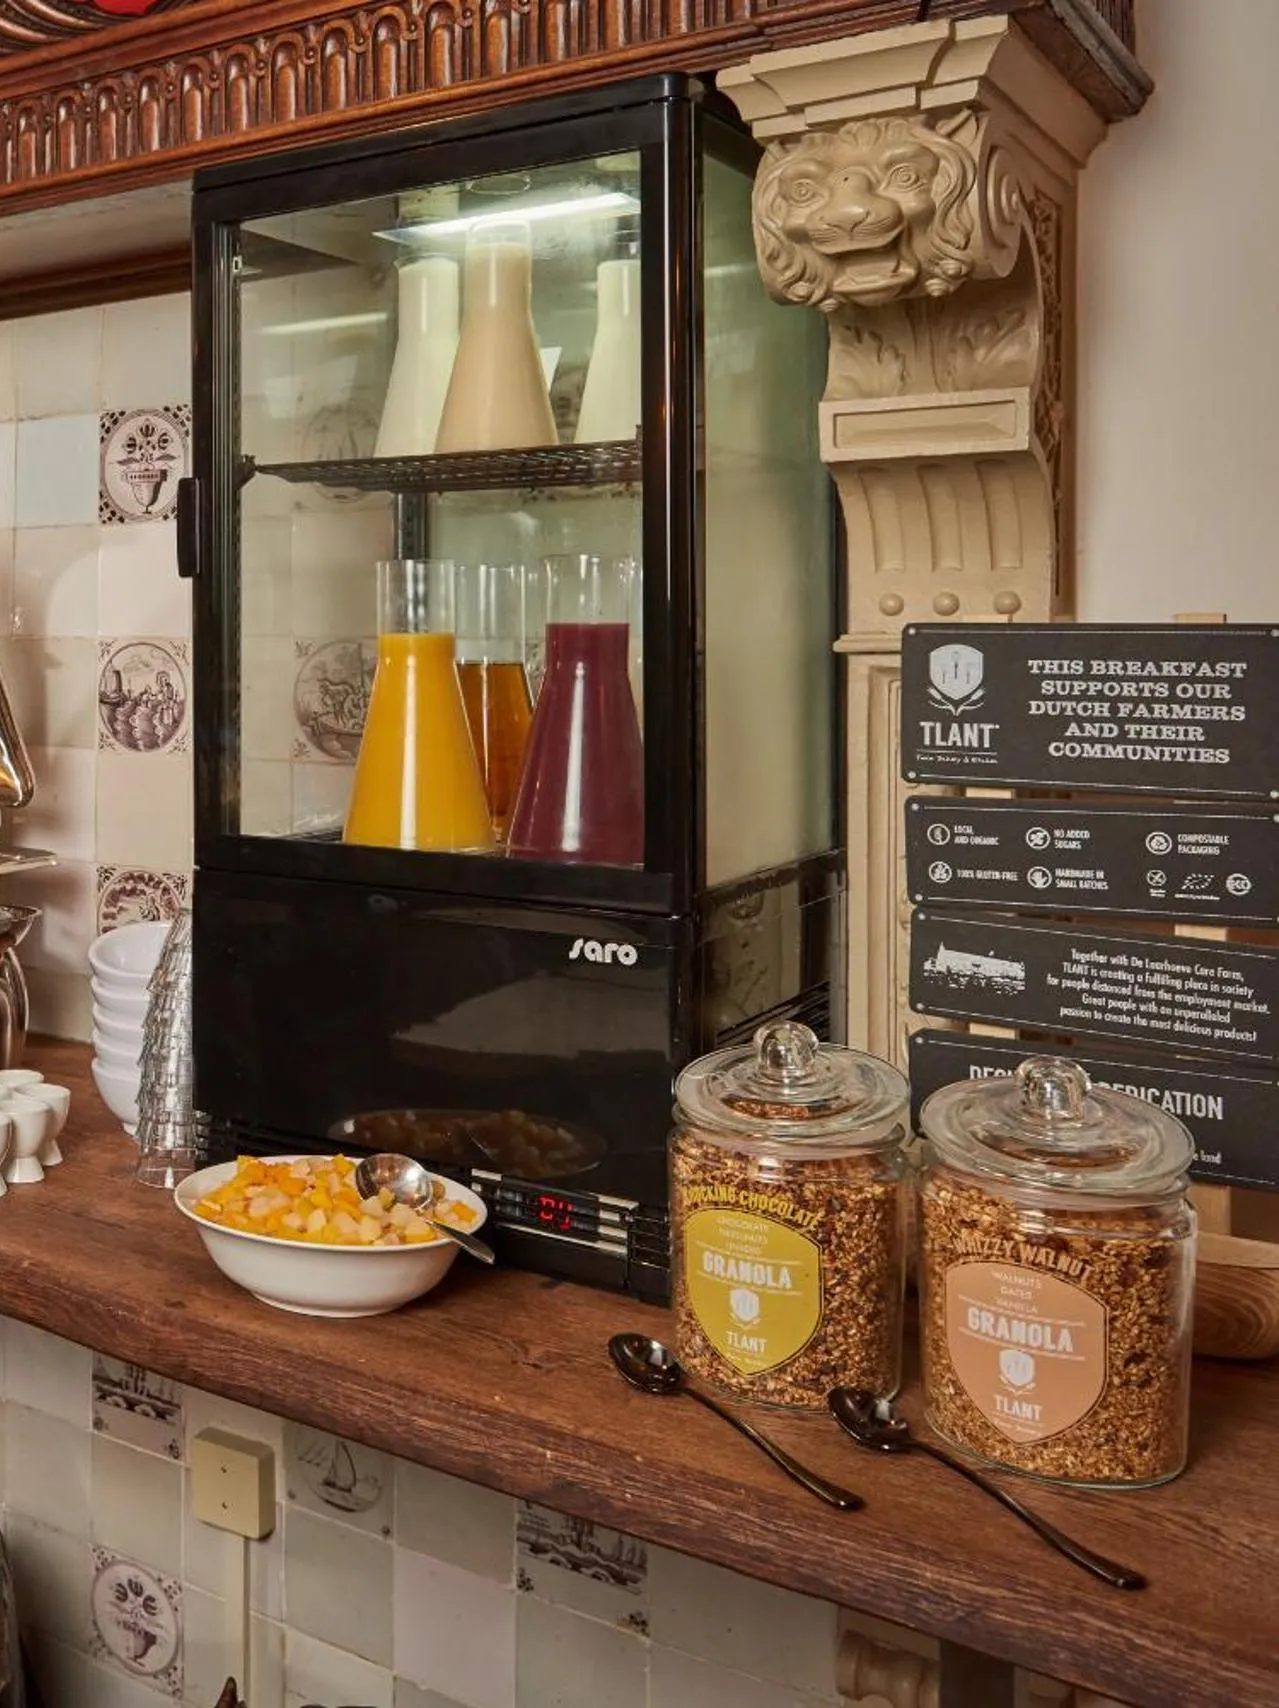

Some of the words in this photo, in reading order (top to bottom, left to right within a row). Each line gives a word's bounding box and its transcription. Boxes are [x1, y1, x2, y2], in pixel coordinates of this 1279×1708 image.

[1028, 659, 1084, 676] THIS
[1090, 660, 1247, 679] BREAKFAST
[1041, 680, 1169, 698] SUPPORTS
[1175, 683, 1232, 700] OUR
[1028, 700, 1111, 718] DUTCH
[1117, 702, 1247, 722] FARMERS
[920, 721, 996, 748] TLANT
[1065, 723, 1119, 739] AND
[1125, 724, 1205, 742] THEIR
[1048, 741, 1230, 764] COMMUNITIES
[1053, 829, 1065, 839] NO
[1065, 829, 1091, 839] ADDED
[1054, 840, 1082, 850] SUGARS
[1055, 879, 1077, 889] SMALL
[1079, 880, 1109, 891] BATCHES
[569, 938, 638, 967] saro
[1071, 947, 1108, 963] Together
[1110, 954, 1129, 966] with
[1194, 963, 1215, 977] Care
[1046, 972, 1060, 986] for
[1061, 977, 1090, 991] people
[1134, 984, 1156, 998] from
[1157, 988, 1173, 1001] the
[1174, 992, 1232, 1009] employment
[1062, 961, 1089, 975] TLANT
[1090, 965, 1098, 977] is
[1100, 970, 1135, 983] creating
[1184, 977, 1208, 991] place
[1210, 981, 1220, 993] in
[1222, 984, 1254, 999] society
[1082, 993, 1106, 1006] Great
[1108, 998, 1137, 1011] people
[1139, 1001, 1158, 1013] with
[1160, 1006, 1173, 1016] an
[1060, 1006, 1092, 1020] passion
[1093, 1010, 1102, 1020] to
[1104, 1012, 1131, 1025] create
[1133, 1014, 1148, 1026] the
[1149, 1018, 1172, 1030] most
[1173, 1020, 1212, 1036] delicious
[1214, 1027, 1257, 1042] products!
[1097, 1082, 1223, 1120] ICATION
[740, 1189, 825, 1231] CHOCOLATE
[702, 1250, 792, 1289] GRANOLA
[1021, 1243, 1095, 1287] WALNUT
[726, 1330, 767, 1353] TLANT
[967, 1306, 1074, 1353] GRANOLA
[994, 1394, 1043, 1421] TLANT
